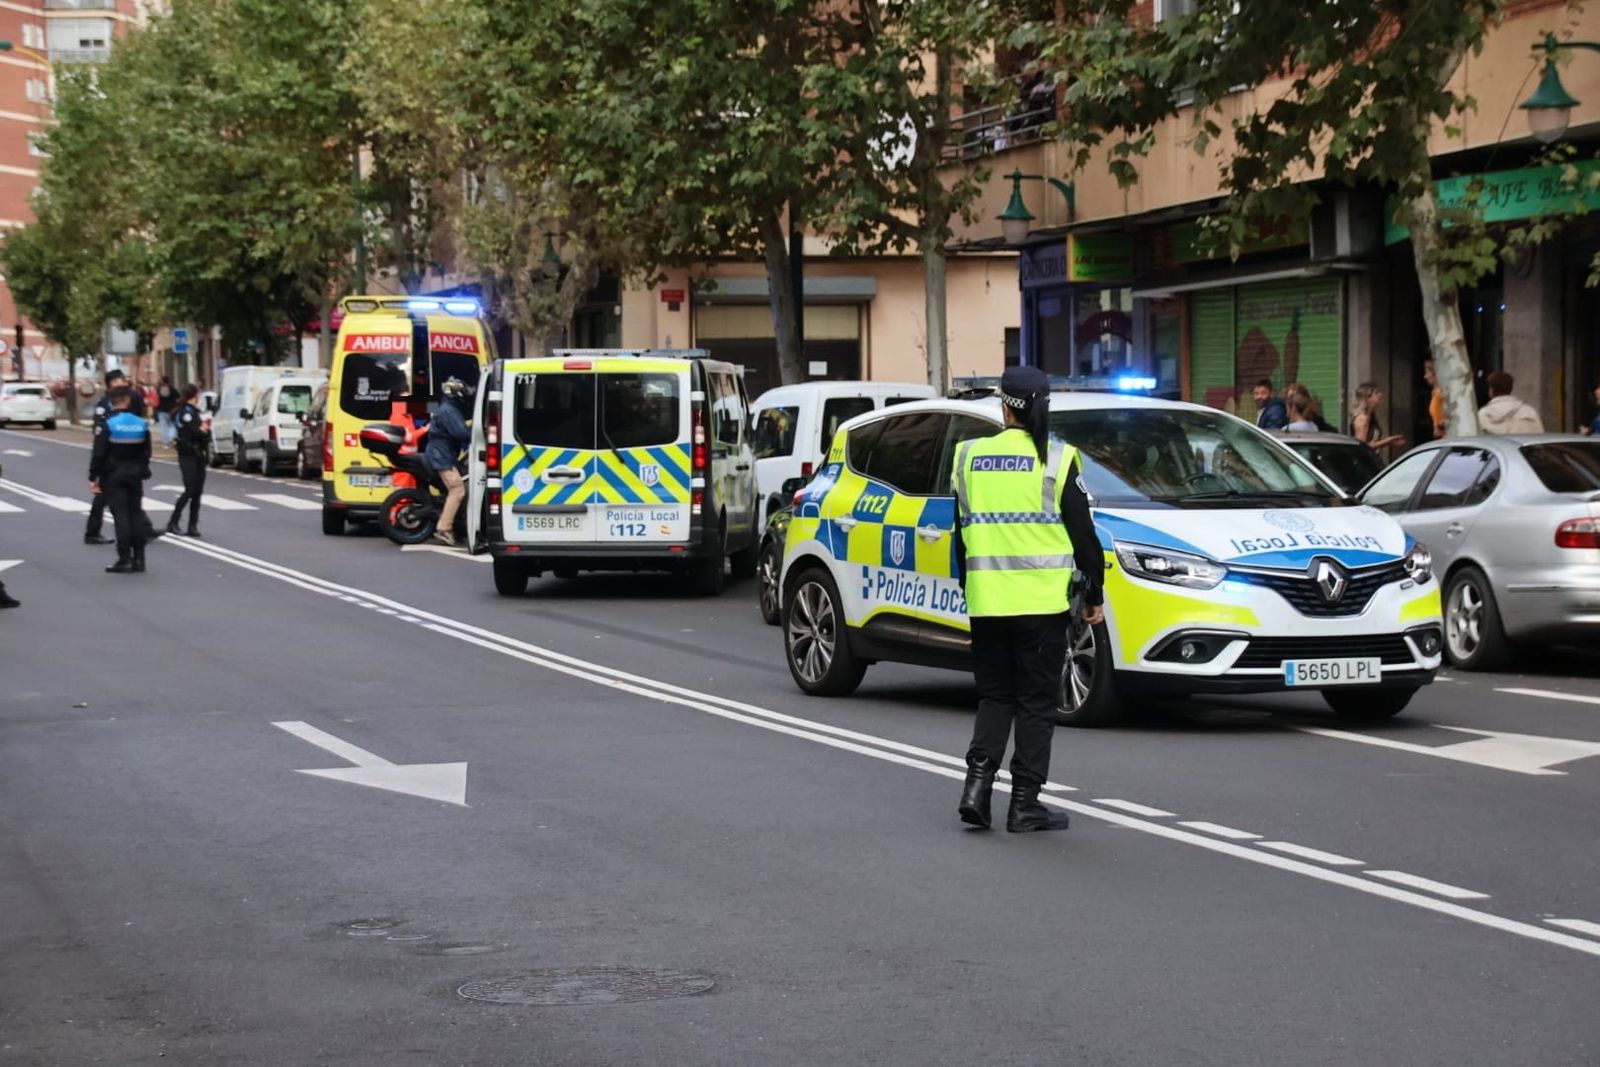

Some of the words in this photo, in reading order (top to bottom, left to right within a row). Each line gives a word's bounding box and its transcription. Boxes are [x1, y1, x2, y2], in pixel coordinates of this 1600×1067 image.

[516, 374, 537, 385] 717
[972, 456, 1030, 471] POLICÍA
[650, 510, 679, 521] Local
[526, 517, 555, 529] 5569
[558, 517, 580, 529] LRC
[616, 523, 647, 537] 112
[876, 570, 926, 608] Policía
[930, 579, 968, 615] Loca
[1298, 662, 1341, 681] 5650
[1346, 661, 1377, 680] LPL
